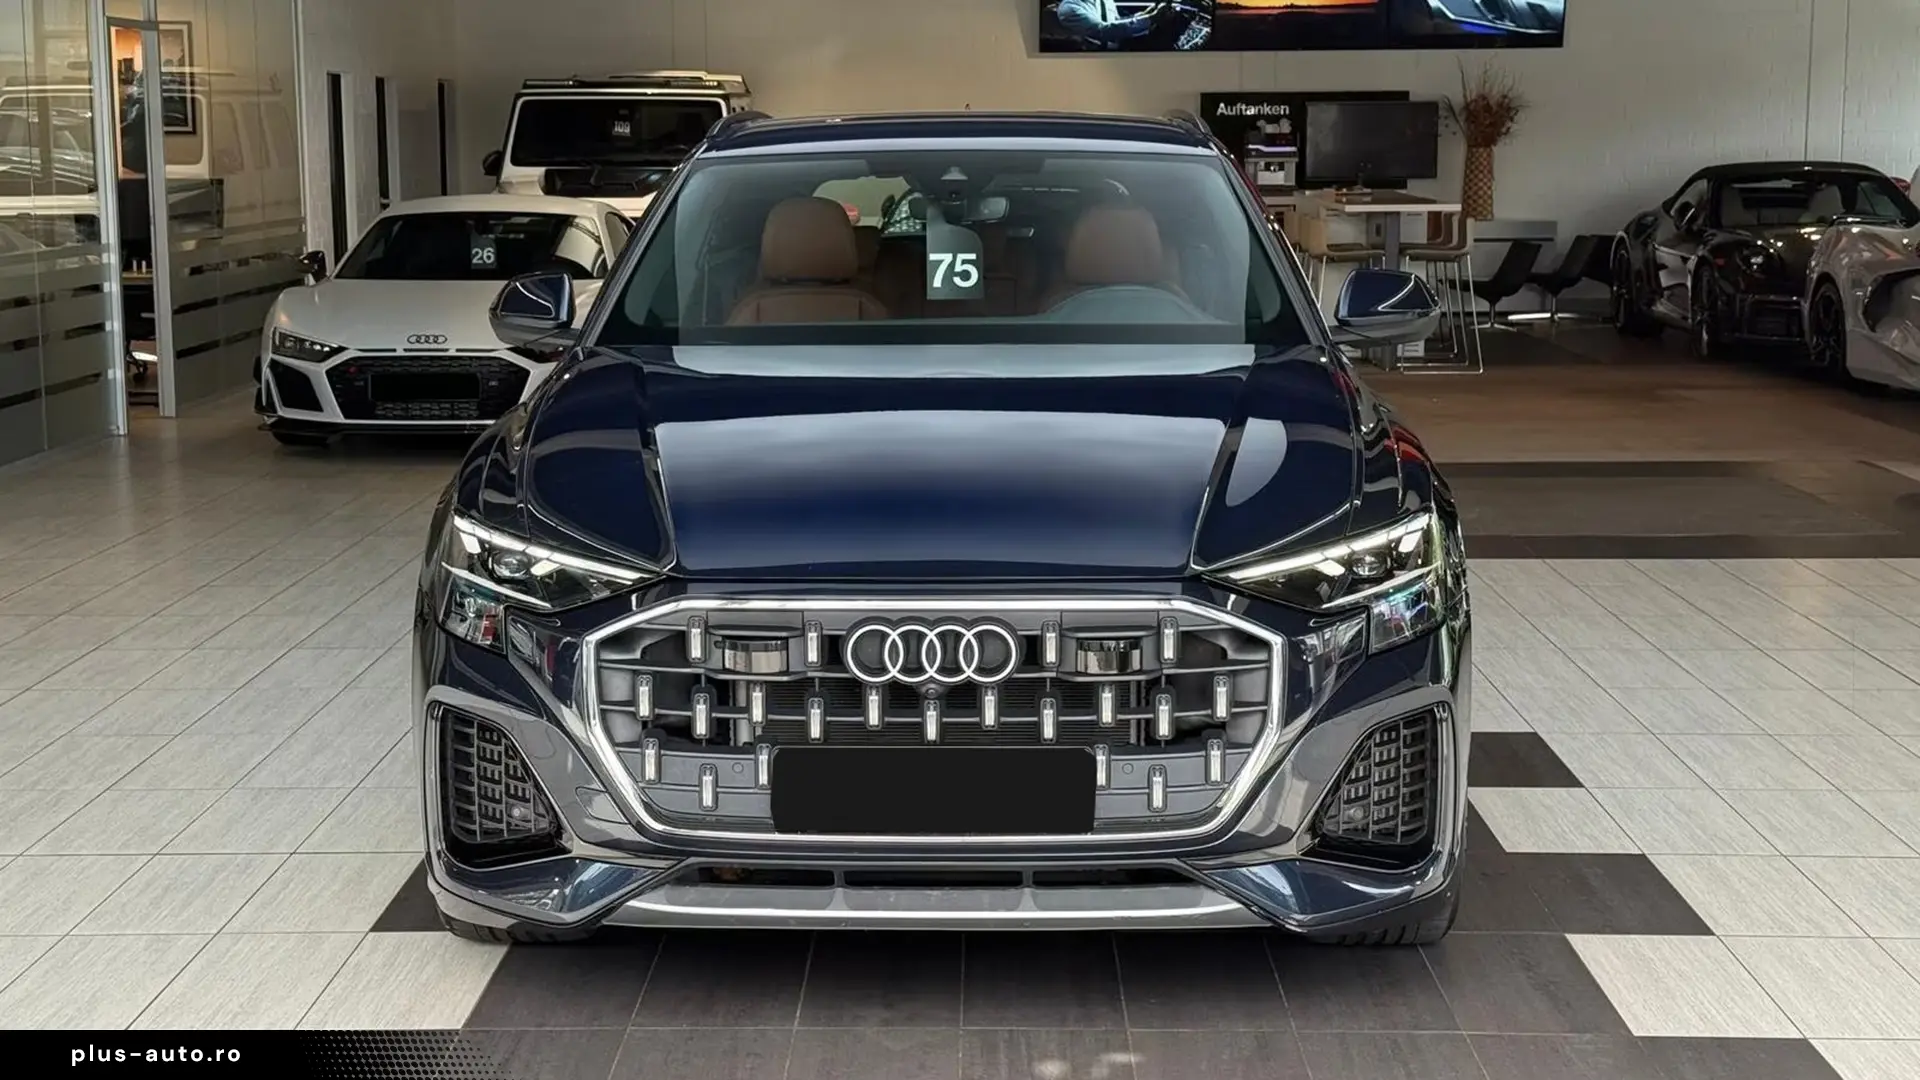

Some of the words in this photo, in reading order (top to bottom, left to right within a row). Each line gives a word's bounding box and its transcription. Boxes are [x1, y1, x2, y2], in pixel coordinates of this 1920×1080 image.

[1216, 101, 1290, 116] Auftanken
[471, 247, 495, 264] 26
[928, 252, 979, 288] 75
